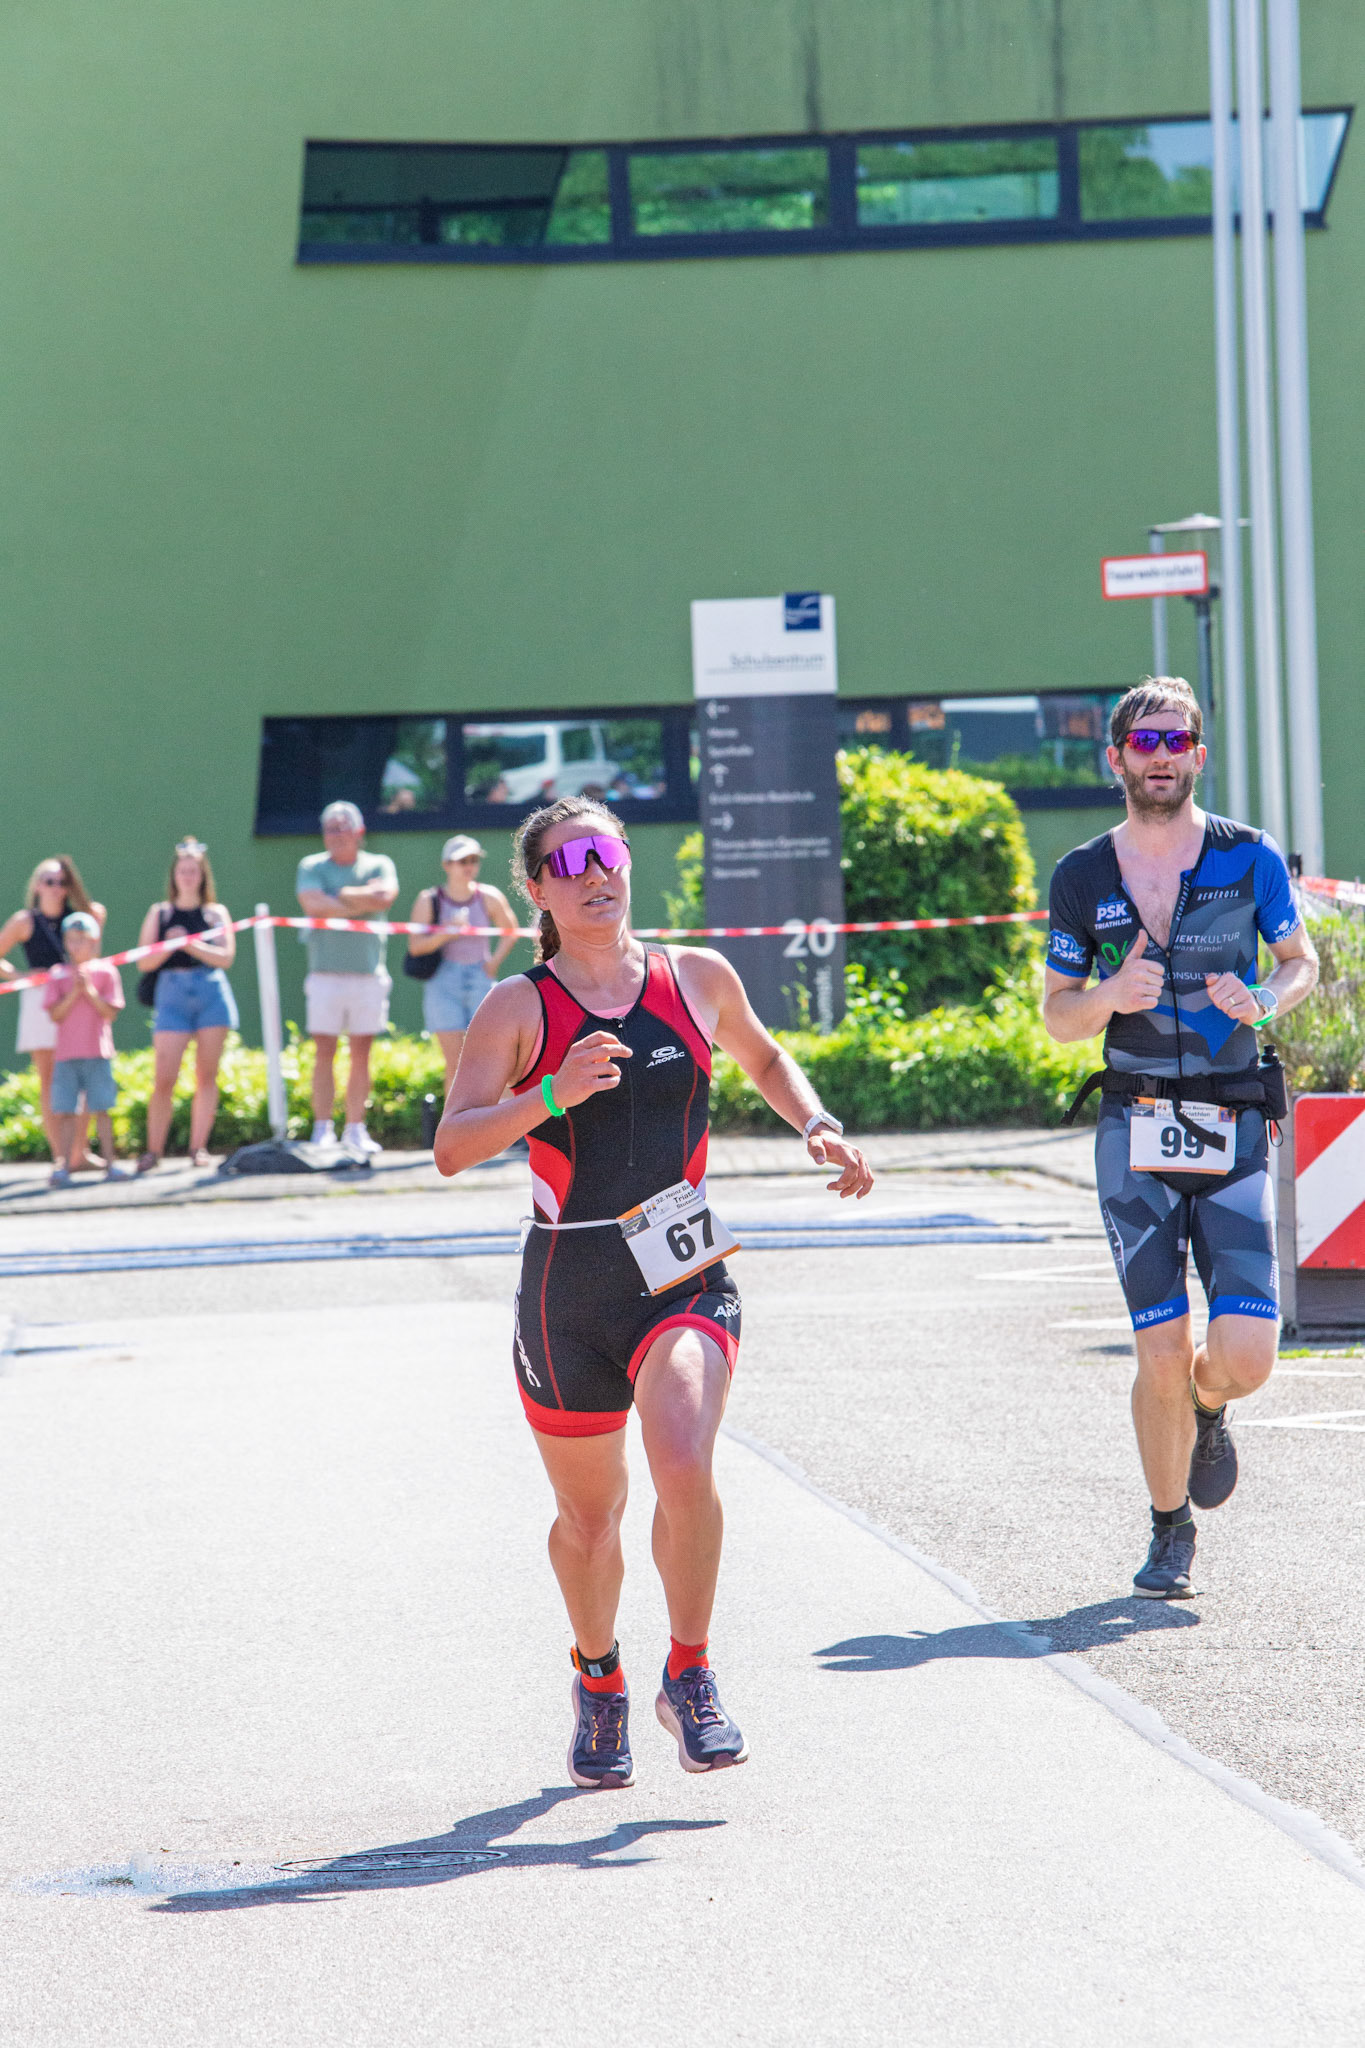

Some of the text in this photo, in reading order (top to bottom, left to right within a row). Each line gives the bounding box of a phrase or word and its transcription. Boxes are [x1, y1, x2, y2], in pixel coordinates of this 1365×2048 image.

[1094, 917, 1133, 931] TRIATHLON
[1096, 903, 1128, 922] PSK
[783, 918, 836, 958] 20
[646, 1051, 686, 1069] AROPEC
[1160, 1126, 1205, 1159] 99
[666, 1207, 715, 1263] 67
